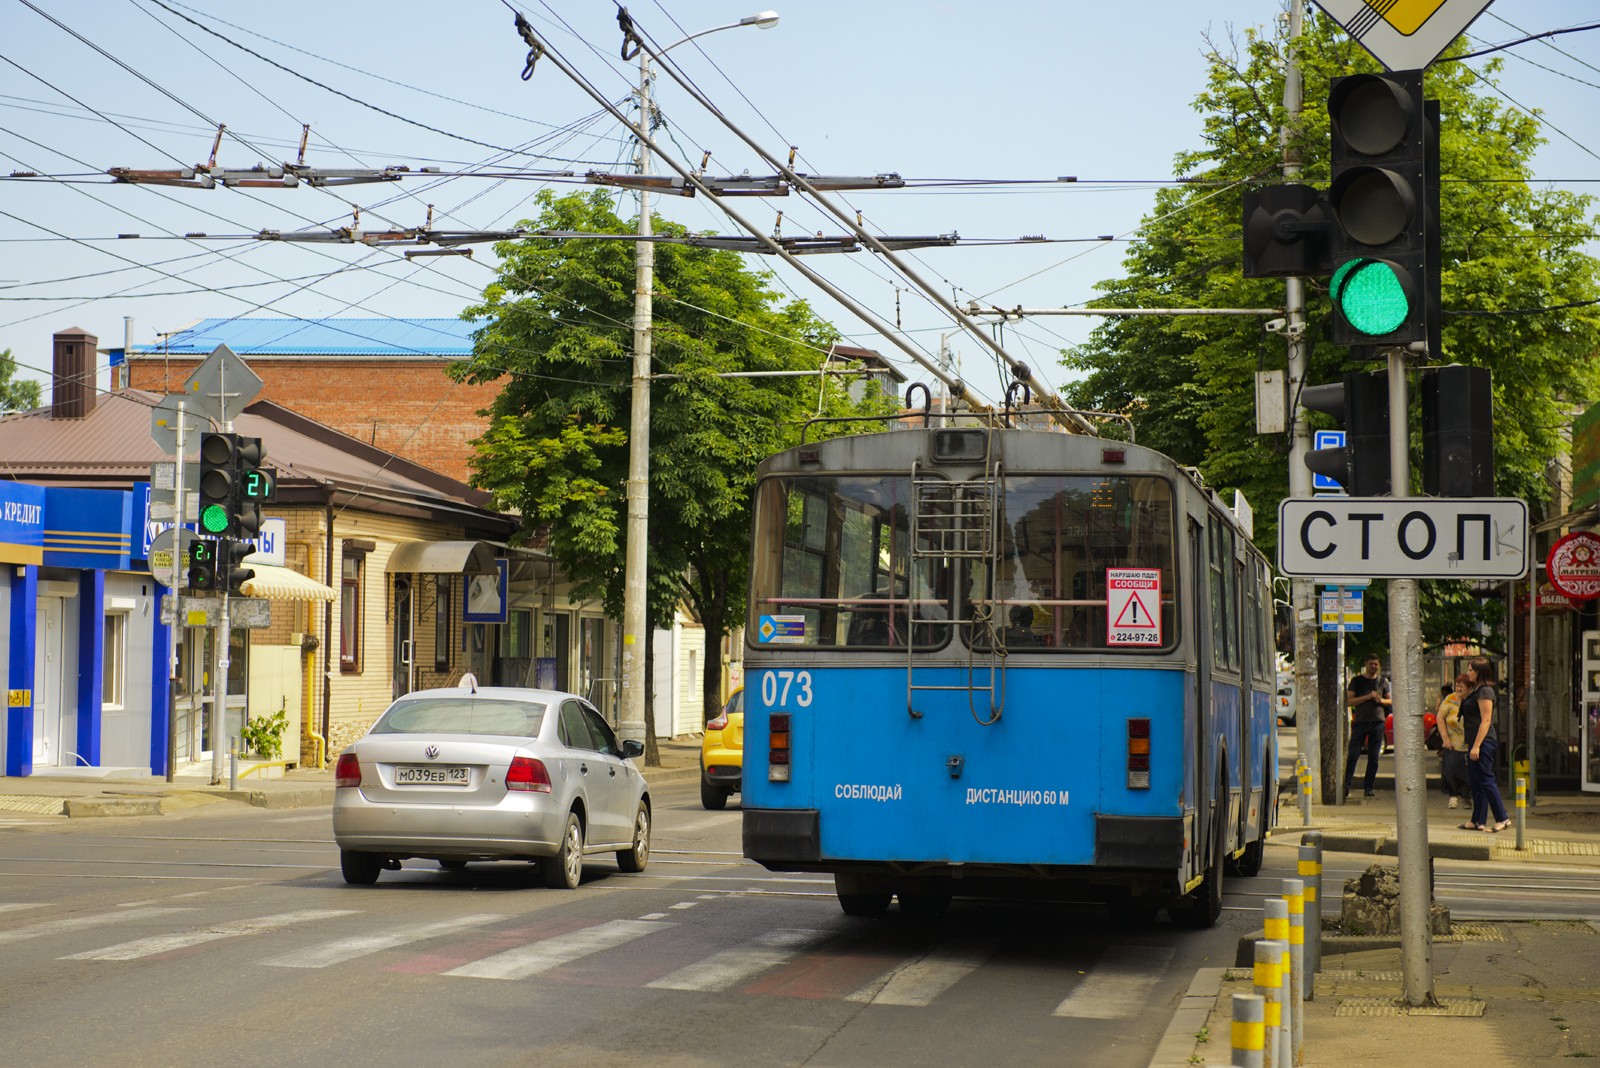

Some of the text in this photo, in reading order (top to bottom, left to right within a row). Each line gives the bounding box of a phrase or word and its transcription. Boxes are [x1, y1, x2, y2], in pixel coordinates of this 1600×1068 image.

[4, 501, 42, 526] КРЕДИТ
[1301, 510, 1491, 560] СТОП
[1561, 568, 1600, 576] МАТРЕШ
[1114, 580, 1153, 589] СООБЩИ
[1116, 633, 1158, 642] 224-97-26
[762, 671, 813, 707] 073
[400, 769, 466, 782] М039ЕВ 123
[834, 783, 1069, 807] СОБЛЮДАЙ ДИСТАНЦИЮ 60 М
